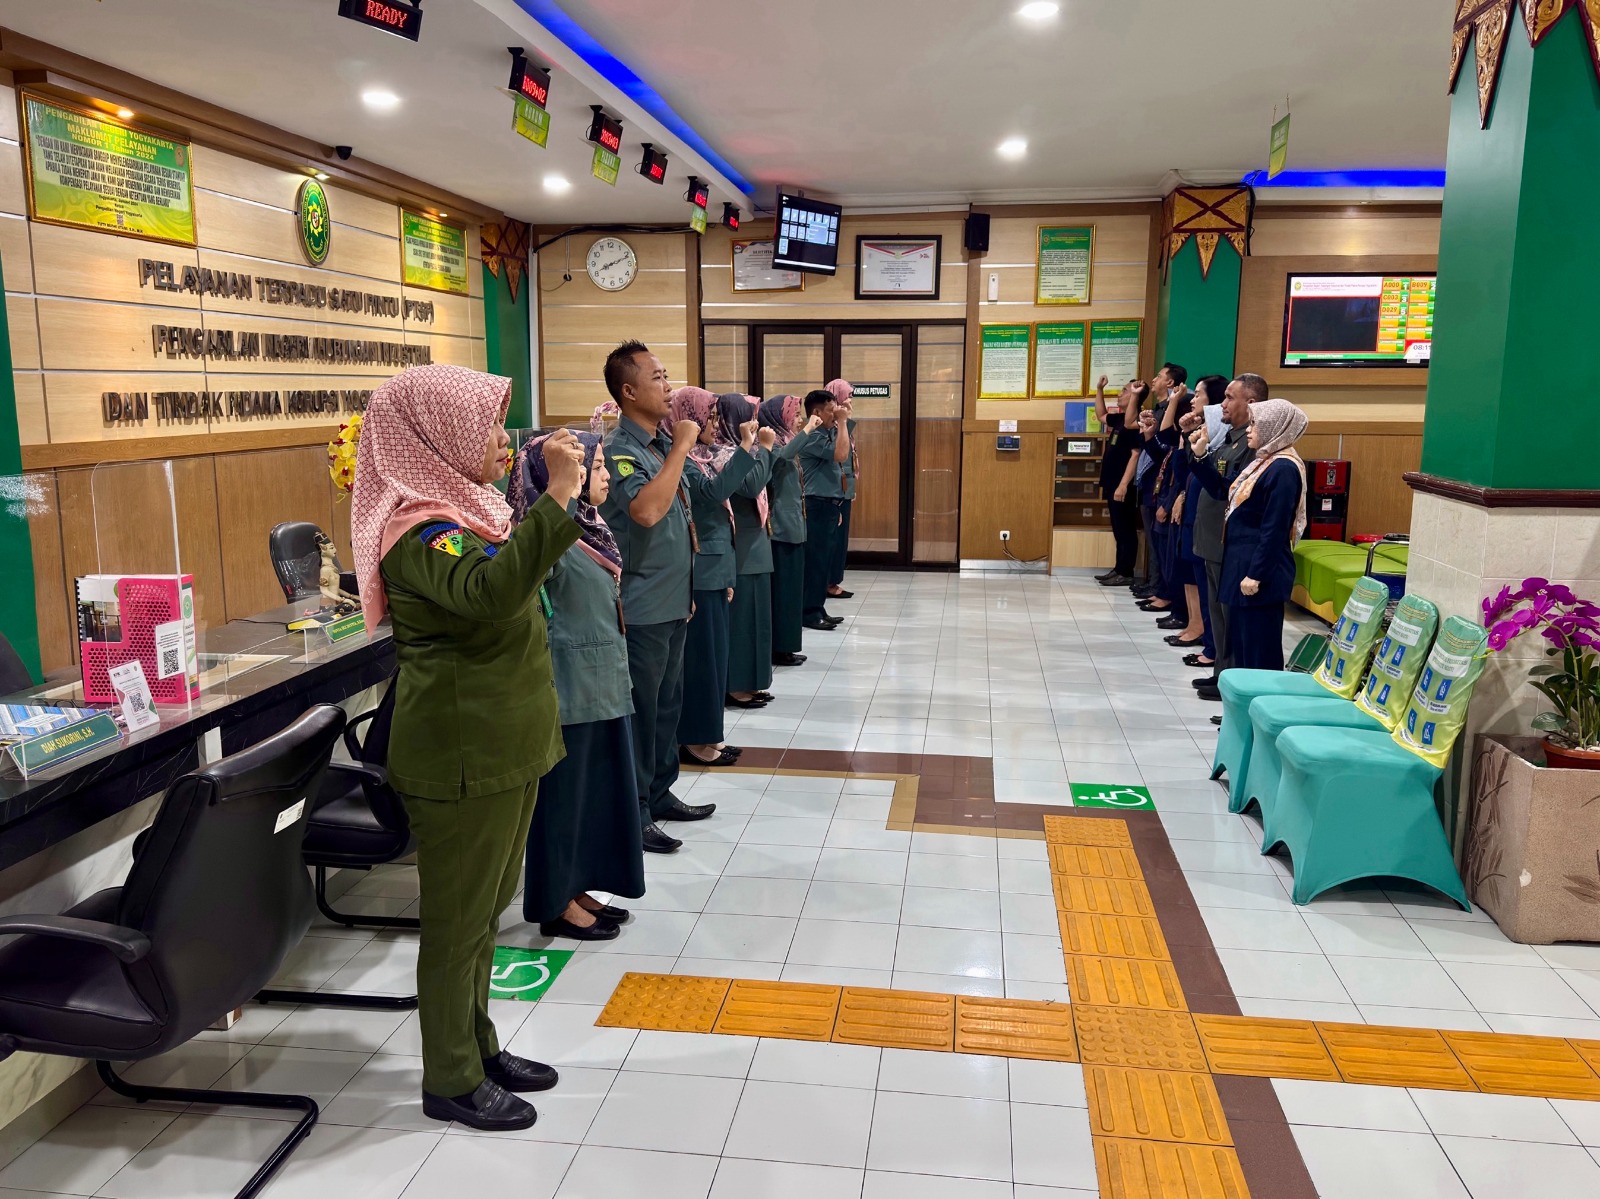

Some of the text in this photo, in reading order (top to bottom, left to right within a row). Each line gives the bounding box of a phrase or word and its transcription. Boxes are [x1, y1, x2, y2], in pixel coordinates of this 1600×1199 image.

[366, 0, 408, 28] READY
[45, 106, 173, 150] PENGADILAN NEGERI YOGYAKARTA
[67, 122, 156, 155] MAKLUMAT PELAYANAN
[71, 132, 102, 147] NOMOR
[112, 143, 133, 155] Tahun
[135, 150, 154, 160] 2024
[138, 258, 252, 299] PELAYANAN
[255, 276, 326, 308] TERPADU
[327, 287, 362, 312] SATU
[364, 293, 399, 317] PINTU
[152, 324, 260, 358] PENGADILAN
[261, 333, 308, 360] NEGERI
[102, 391, 149, 422] DAN
[151, 391, 224, 420] TINDAK
[224, 390, 283, 417] PIDANA
[283, 390, 339, 415] KORUPSI
[451, 536, 460, 545] S
[40, 726, 95, 754] DIAH SUKORINI, S.H.
